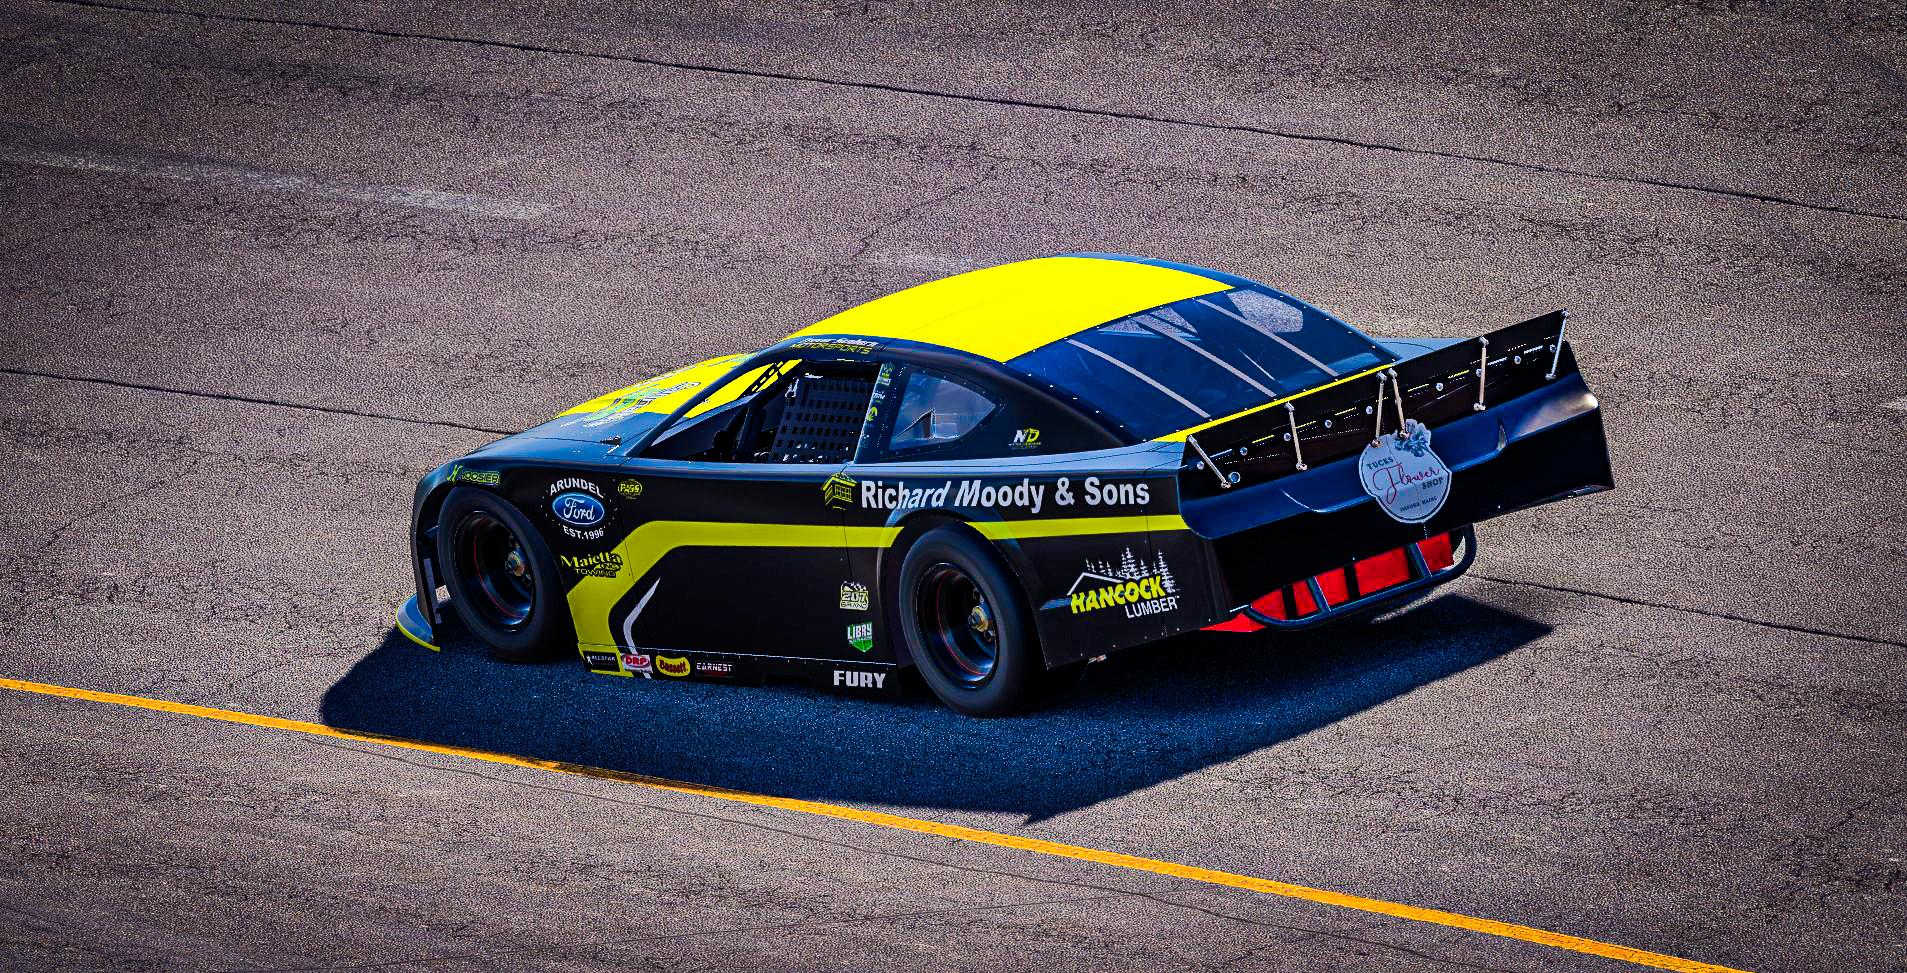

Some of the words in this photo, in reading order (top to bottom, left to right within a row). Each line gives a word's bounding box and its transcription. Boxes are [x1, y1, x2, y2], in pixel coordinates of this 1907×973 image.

[1366, 457, 1394, 470] TUCKS
[550, 478, 604, 499] ARUNDEL
[1373, 463, 1440, 505] Flower
[1422, 476, 1443, 490] SHOP
[861, 480, 951, 510] Richard
[953, 478, 1045, 514] Moody
[1054, 476, 1076, 506] &
[1084, 476, 1151, 506] Sons
[563, 497, 595, 521] Ford
[560, 552, 622, 568] Maietta
[1070, 575, 1166, 614] HANCOCK
[1124, 596, 1178, 619] LUMBER
[625, 655, 648, 665] DRP
[696, 662, 733, 672] EARNEST
[833, 670, 886, 689] FURY
